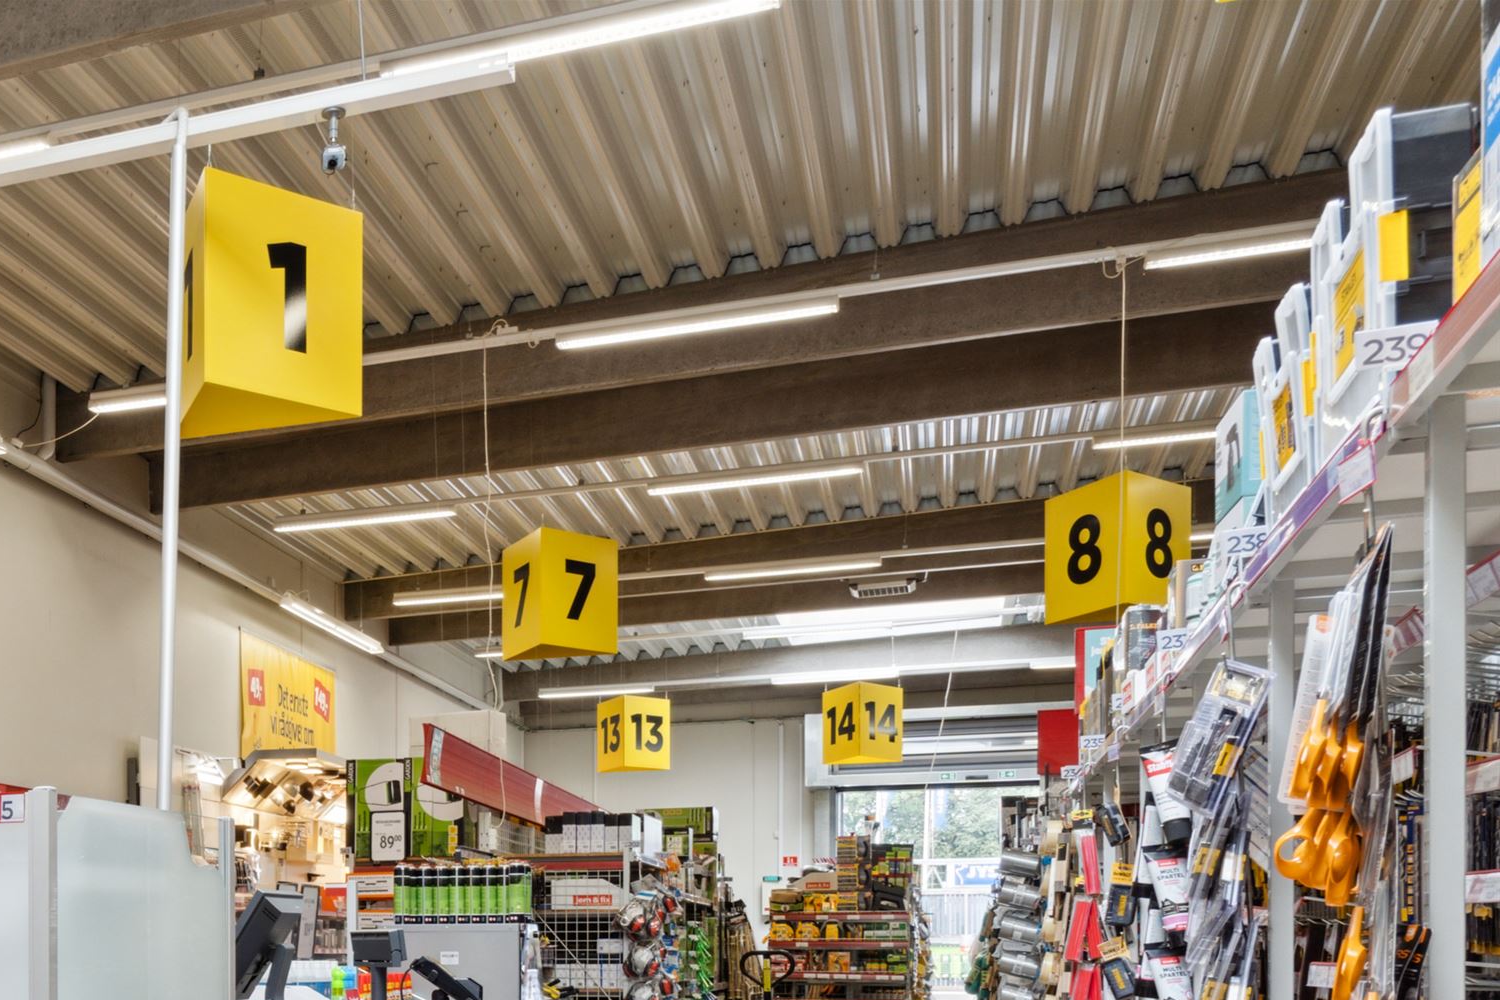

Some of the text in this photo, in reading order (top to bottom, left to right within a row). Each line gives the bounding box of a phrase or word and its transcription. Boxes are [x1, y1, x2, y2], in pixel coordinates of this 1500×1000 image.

[267, 242, 307, 354] 1
[1067, 514, 1102, 585] 8
[1145, 508, 1173, 578] 8
[514, 562, 530, 629] 7
[565, 558, 596, 621] 7
[1161, 633, 1187, 650] 23
[601, 713, 621, 754] 13
[631, 713, 664, 753] 13
[827, 700, 856, 745] 14
[865, 700, 899, 743] 14
[1, 801, 14, 820] 5
